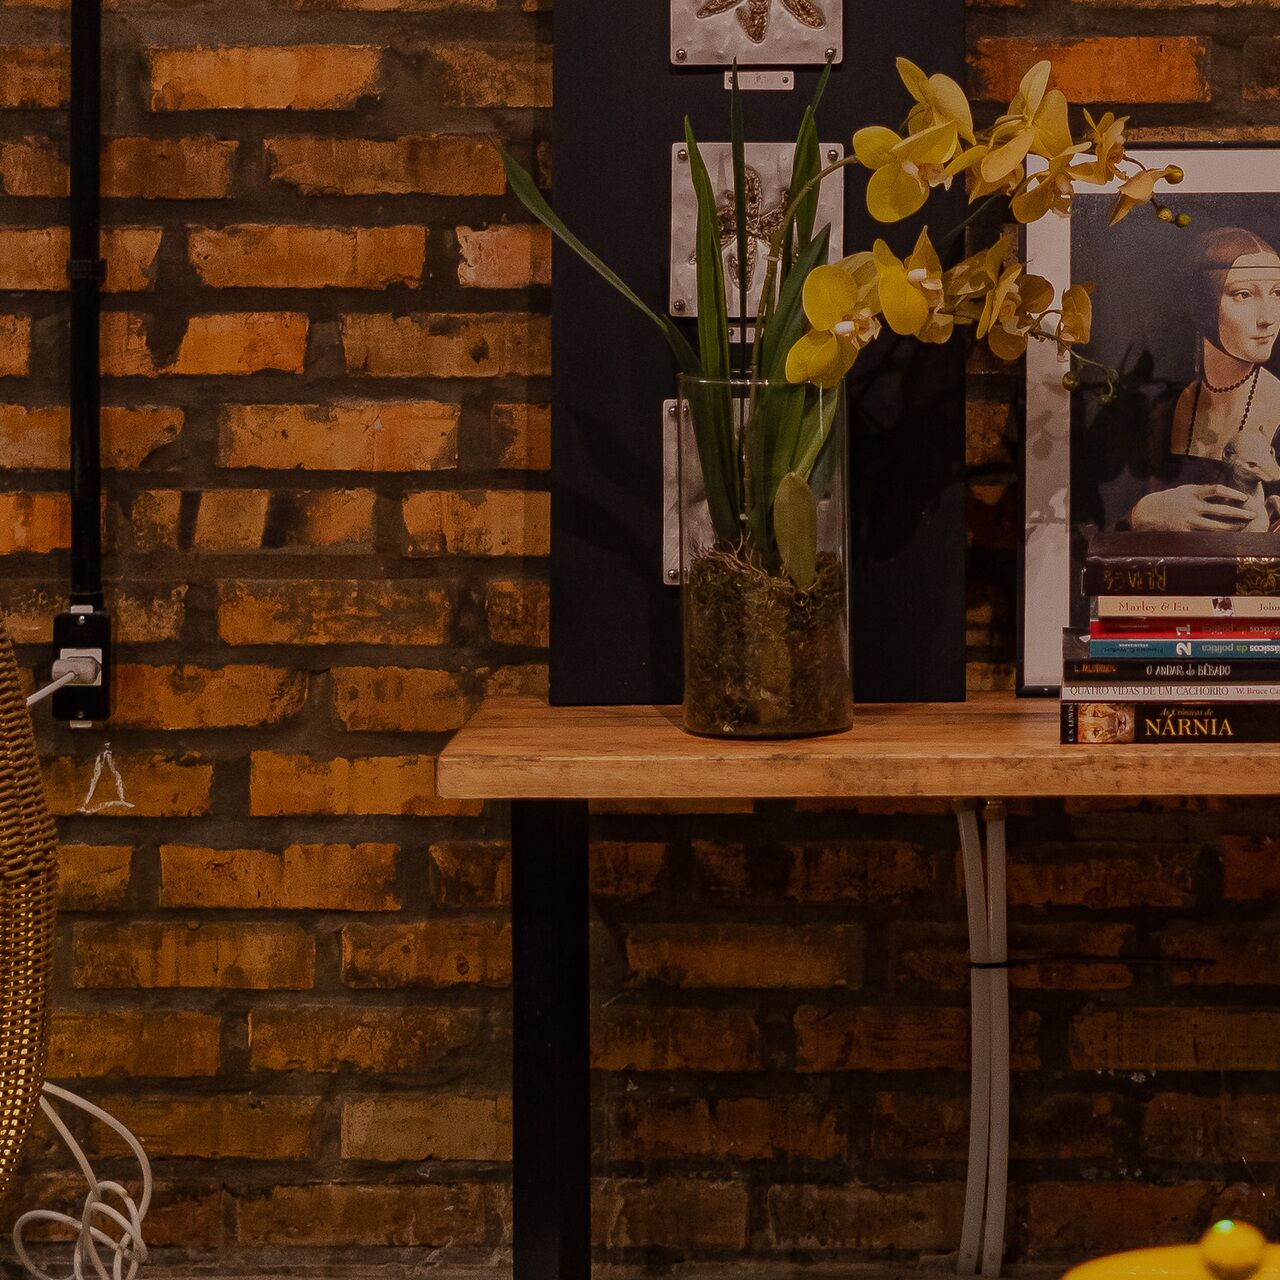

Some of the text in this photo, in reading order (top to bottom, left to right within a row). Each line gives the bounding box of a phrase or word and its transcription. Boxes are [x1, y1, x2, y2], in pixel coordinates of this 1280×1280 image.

[1118, 601, 1190, 613] Marley & Eu
[1259, 602, 1280, 612] John
[1176, 642, 1192, 656] 2
[1201, 643, 1234, 655] política
[1236, 644, 1248, 655] da
[1146, 665, 1152, 675] O
[1154, 664, 1184, 676] ANDAR
[1197, 661, 1232, 676] BÊBADO
[1070, 686, 1229, 697] QUATRO VIDAS DE UM CACHORRO
[1235, 687, 1246, 696] W.
[1247, 687, 1268, 696] Bruce
[1067, 704, 1075, 728] LEWIS
[1171, 706, 1203, 717] Crônicas
[1203, 707, 1214, 717] de
[1144, 713, 1235, 737] NÁRNIA
